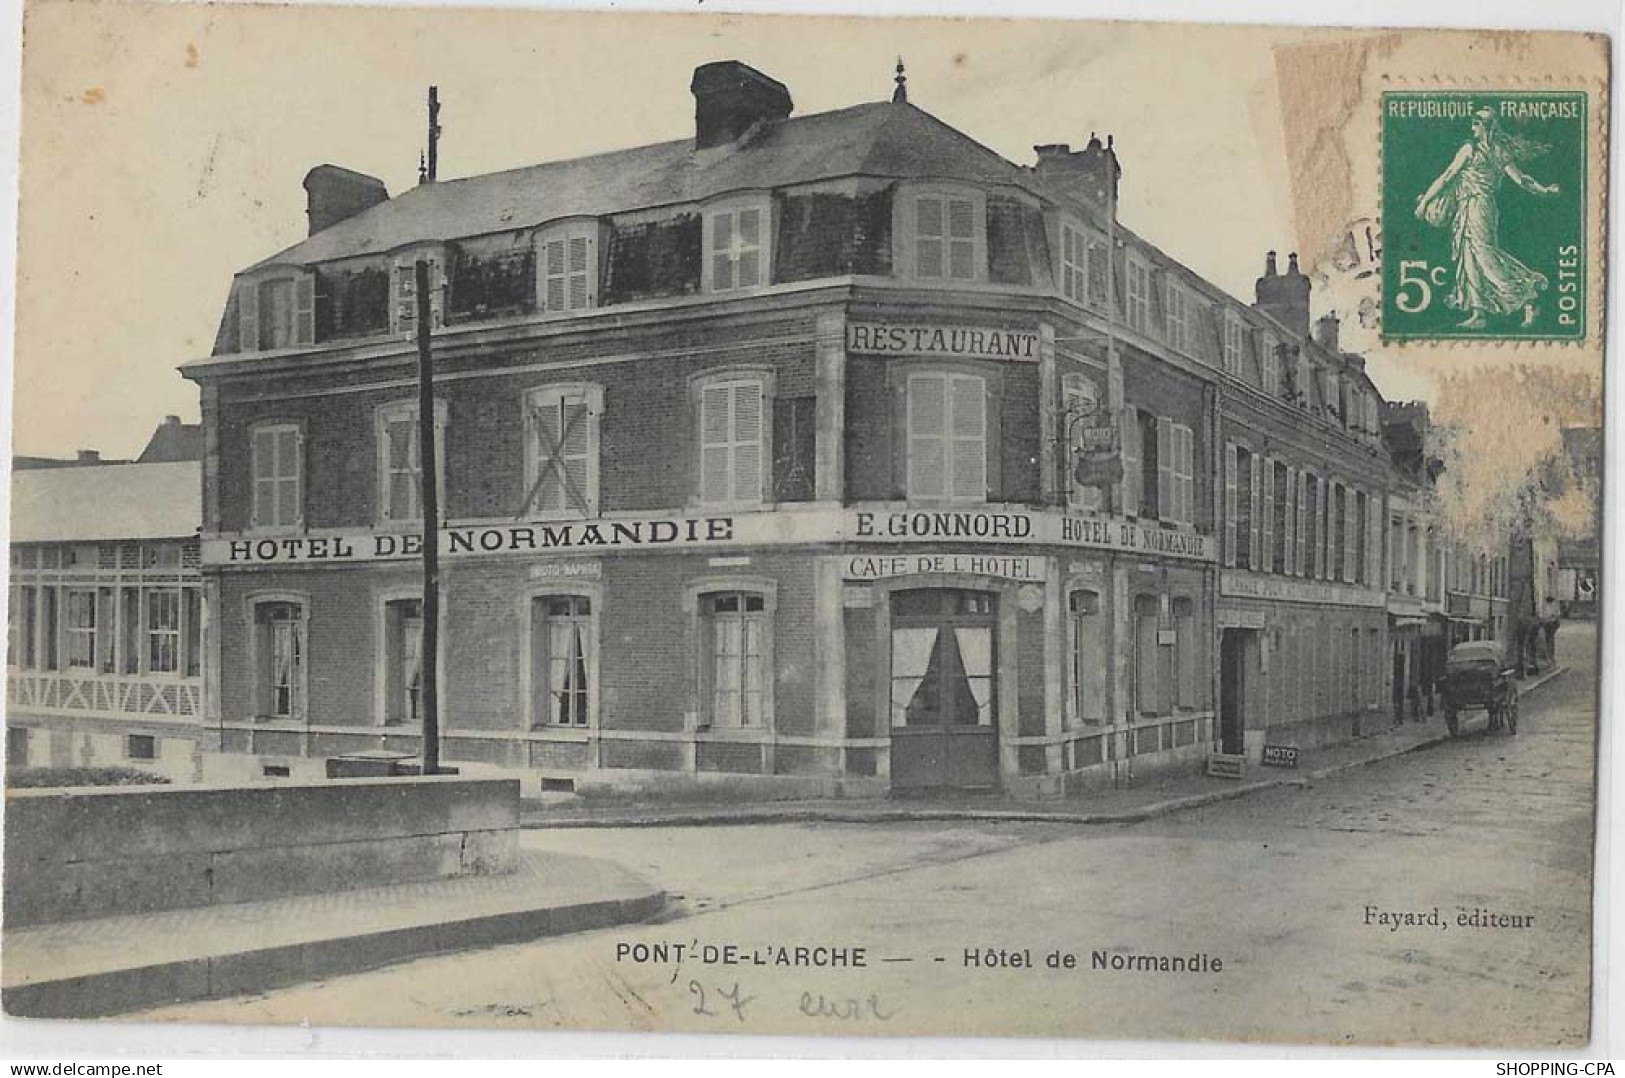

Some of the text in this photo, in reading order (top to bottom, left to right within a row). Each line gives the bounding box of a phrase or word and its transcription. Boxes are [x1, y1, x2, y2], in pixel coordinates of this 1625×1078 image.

[1558, 245, 1577, 325] POSTES
[229, 517, 734, 561] HOTEL DE NORMANDIE
[1061, 516, 1111, 544] HOTEL
[1120, 524, 1137, 547] DE
[917, 556, 946, 574] DE
